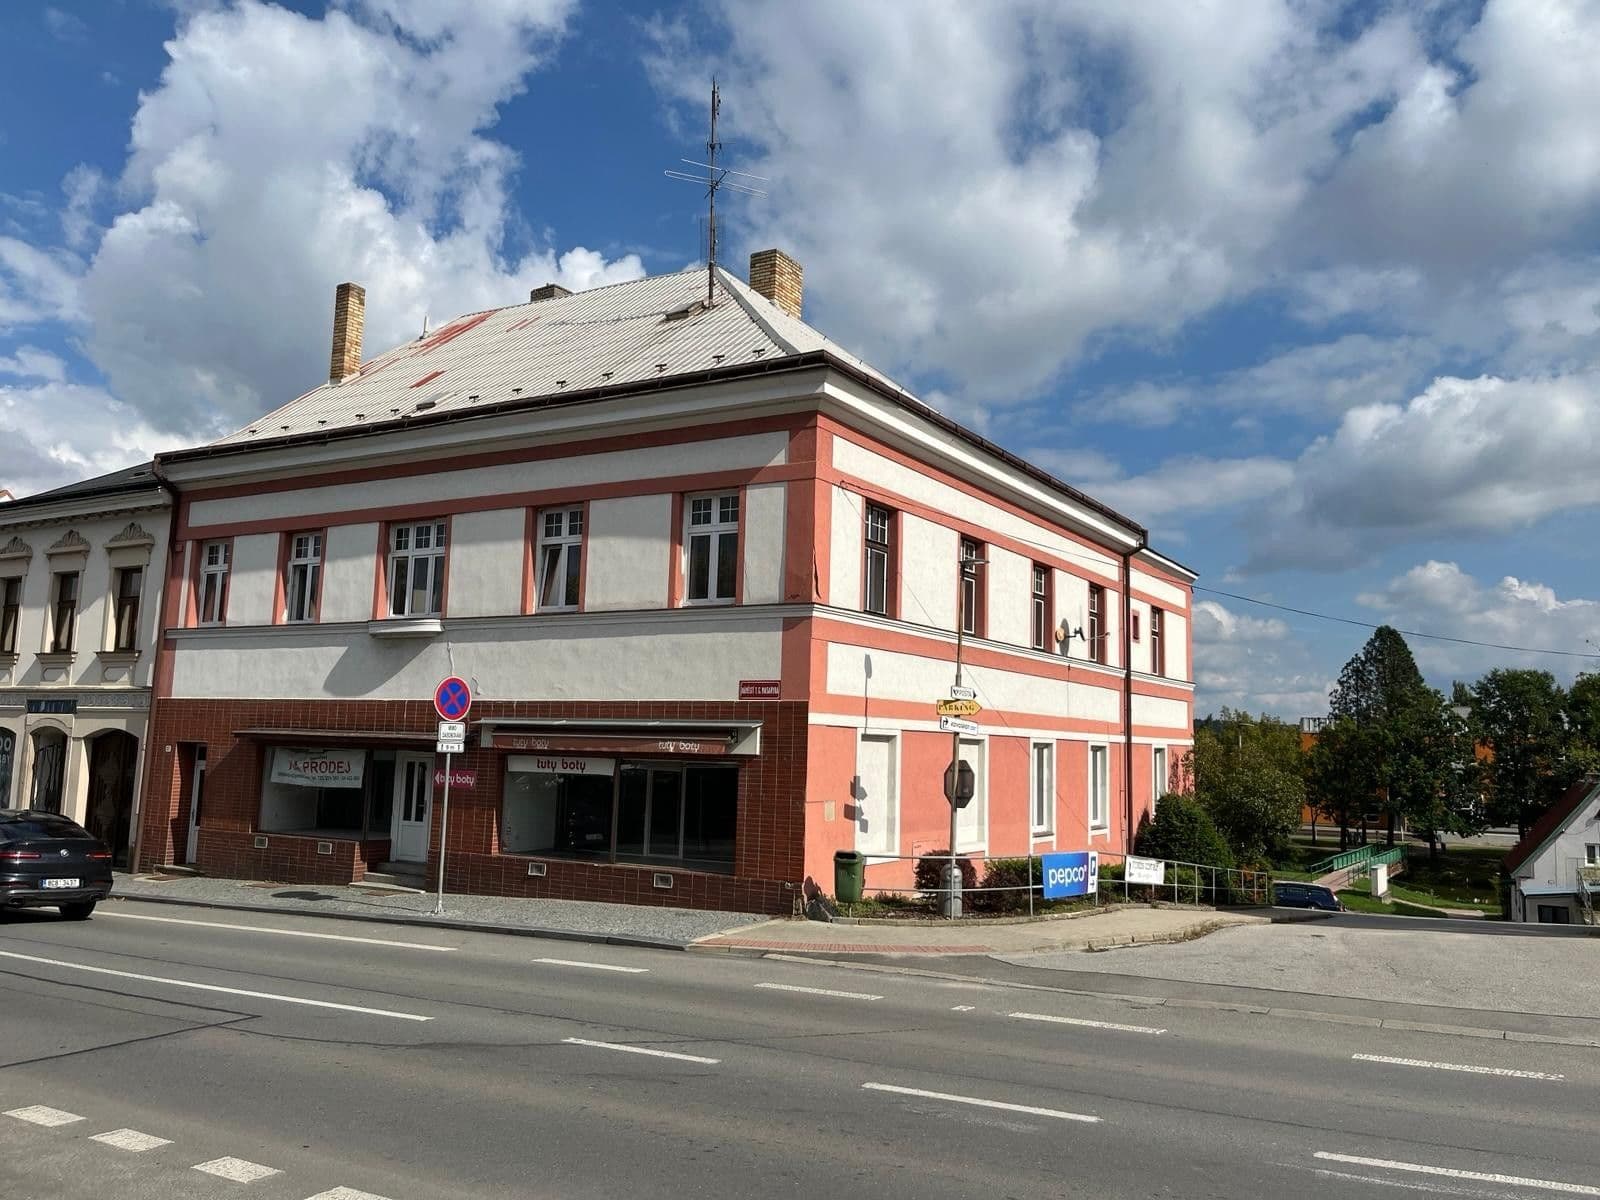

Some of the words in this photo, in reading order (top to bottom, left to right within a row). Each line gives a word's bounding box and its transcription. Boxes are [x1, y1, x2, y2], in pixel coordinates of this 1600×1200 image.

[938, 703, 976, 711] PARKING
[658, 741, 676, 752] tuty
[679, 742, 700, 753] boty
[303, 760, 351, 774] PRODEJ
[537, 758, 557, 773] tuty
[562, 759, 586, 774] boty
[456, 773, 475, 787] boty
[1048, 866, 1085, 888] pepco
